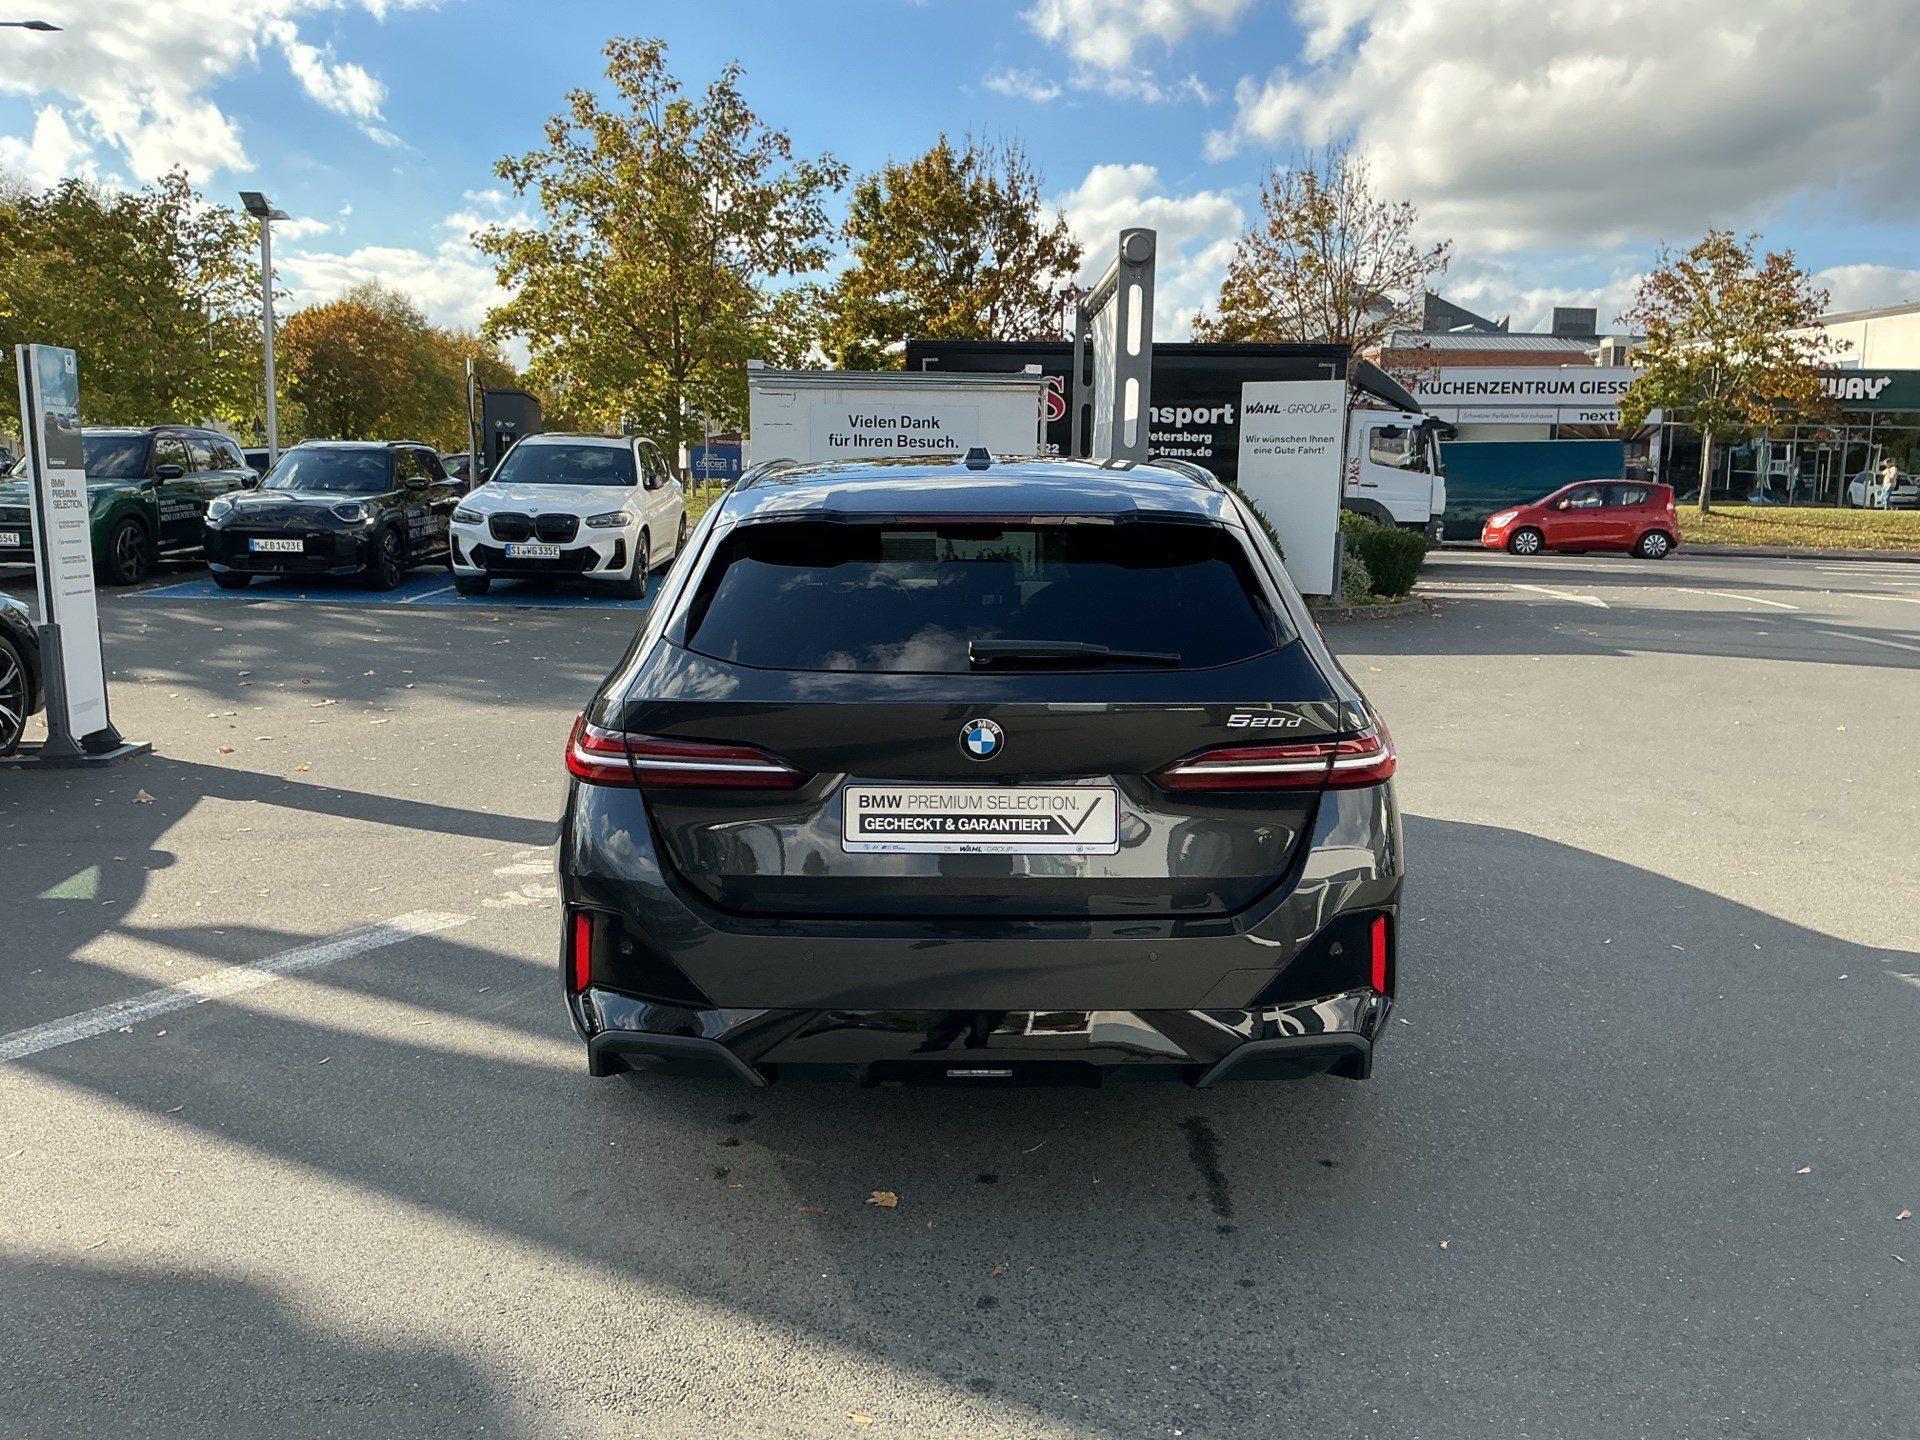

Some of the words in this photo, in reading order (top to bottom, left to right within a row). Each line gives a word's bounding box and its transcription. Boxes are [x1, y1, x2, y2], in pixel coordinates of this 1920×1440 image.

[848, 415, 896, 428] Vielen
[901, 416, 940, 429] Dank
[829, 434, 850, 448] für
[854, 434, 893, 448] Ihren
[897, 435, 959, 449] Besuch.
[1148, 431, 1212, 444] etersberg
[1246, 435, 1259, 443] Wir
[1262, 435, 1307, 443] wünschen
[1309, 435, 1335, 443] Ihnen
[1274, 446, 1295, 454] Gute
[1298, 446, 1325, 455] Fahrt!
[50, 479, 66, 488] BMW
[51, 489, 77, 499] PREMIUM
[1226, 714, 1303, 728] 520d
[858, 795, 903, 808] BMW
[908, 796, 982, 809] PREMIUM
[987, 796, 1080, 810] SELECTION.
[864, 818, 943, 831] GECHECKT
[945, 818, 956, 831] &
[958, 818, 1051, 831] GARANTIERT
